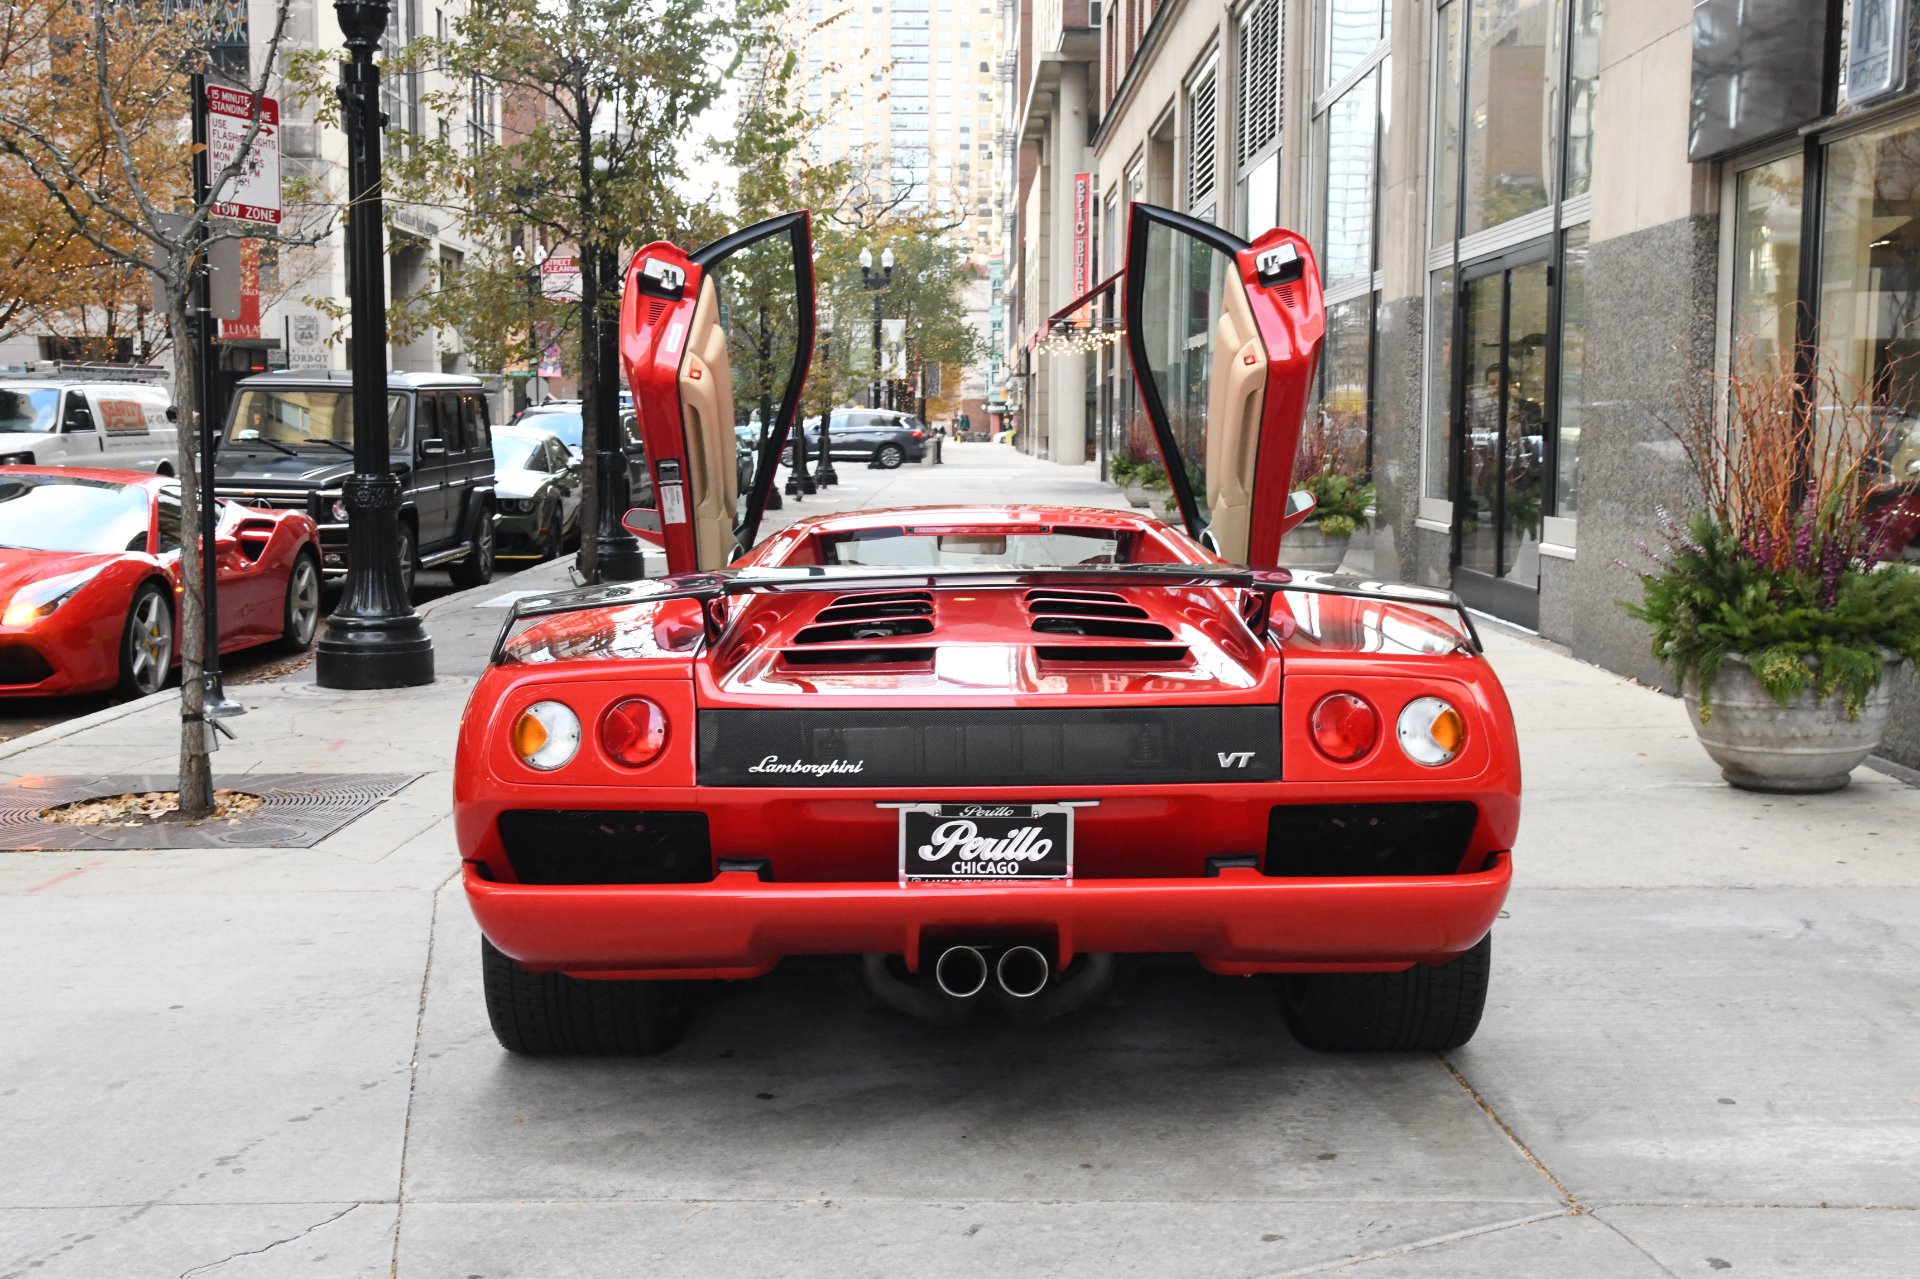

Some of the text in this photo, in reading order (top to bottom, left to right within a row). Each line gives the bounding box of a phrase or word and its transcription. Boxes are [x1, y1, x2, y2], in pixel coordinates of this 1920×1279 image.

[211, 89, 249, 105] 15 MINUTE
[211, 100, 249, 117] STANDING
[212, 118, 227, 130] USE
[213, 140, 220, 150] 10
[222, 142, 235, 151] AM
[213, 151, 230, 161] MON
[213, 161, 221, 172] 10
[215, 203, 276, 222] TOW ZONE
[1074, 180, 1086, 320] EPIC BURGR
[221, 324, 260, 335] LUMA
[748, 755, 864, 778] Lamborghini
[1217, 752, 1256, 769] VT
[959, 805, 1014, 817] Perillo
[918, 820, 1053, 862] Perillo
[951, 861, 1019, 875] CHICAGO
